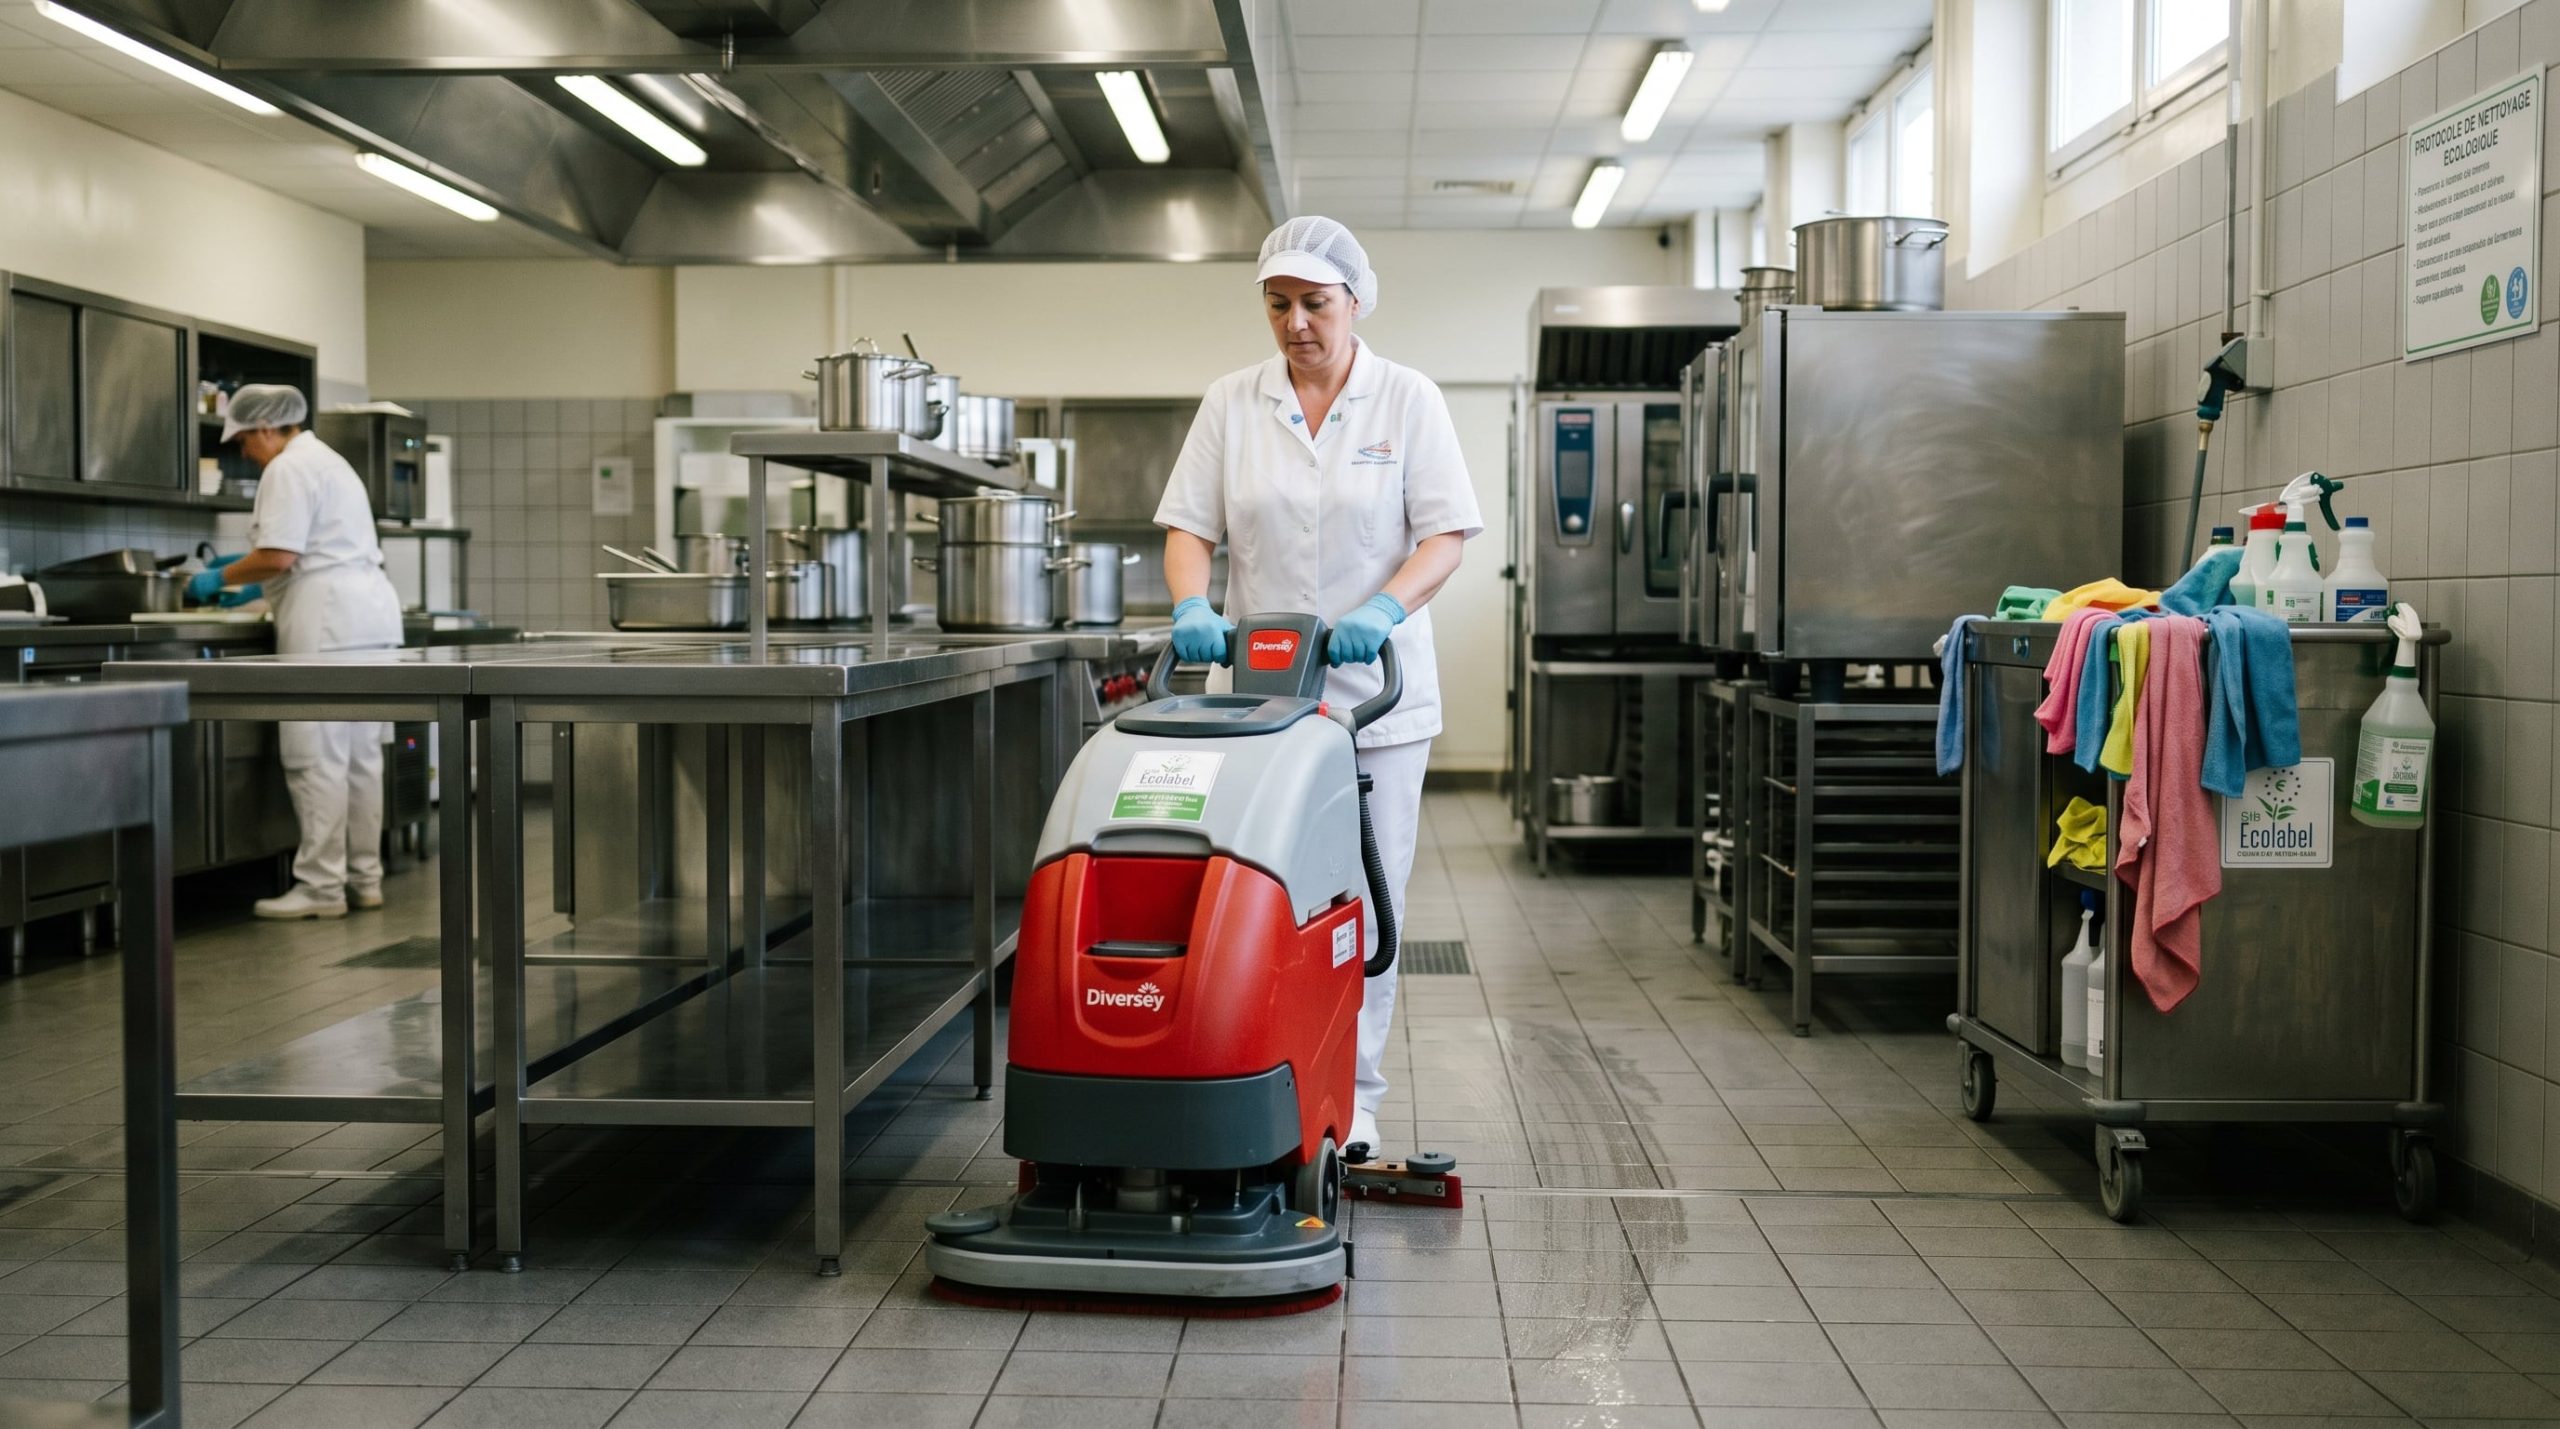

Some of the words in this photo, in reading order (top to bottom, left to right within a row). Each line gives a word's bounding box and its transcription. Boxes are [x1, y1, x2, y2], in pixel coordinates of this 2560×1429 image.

[2415, 121, 2463, 156] PROTOCOLE
[2464, 114, 2476, 134] DE
[2478, 89, 2531, 128] NETTOYAGE
[2443, 128, 2499, 167] ECOLOGIQUE
[1139, 773, 1196, 786] Ecolabel
[2240, 822, 2313, 848] Ecolabel
[1086, 988, 1165, 1012] Diversey
